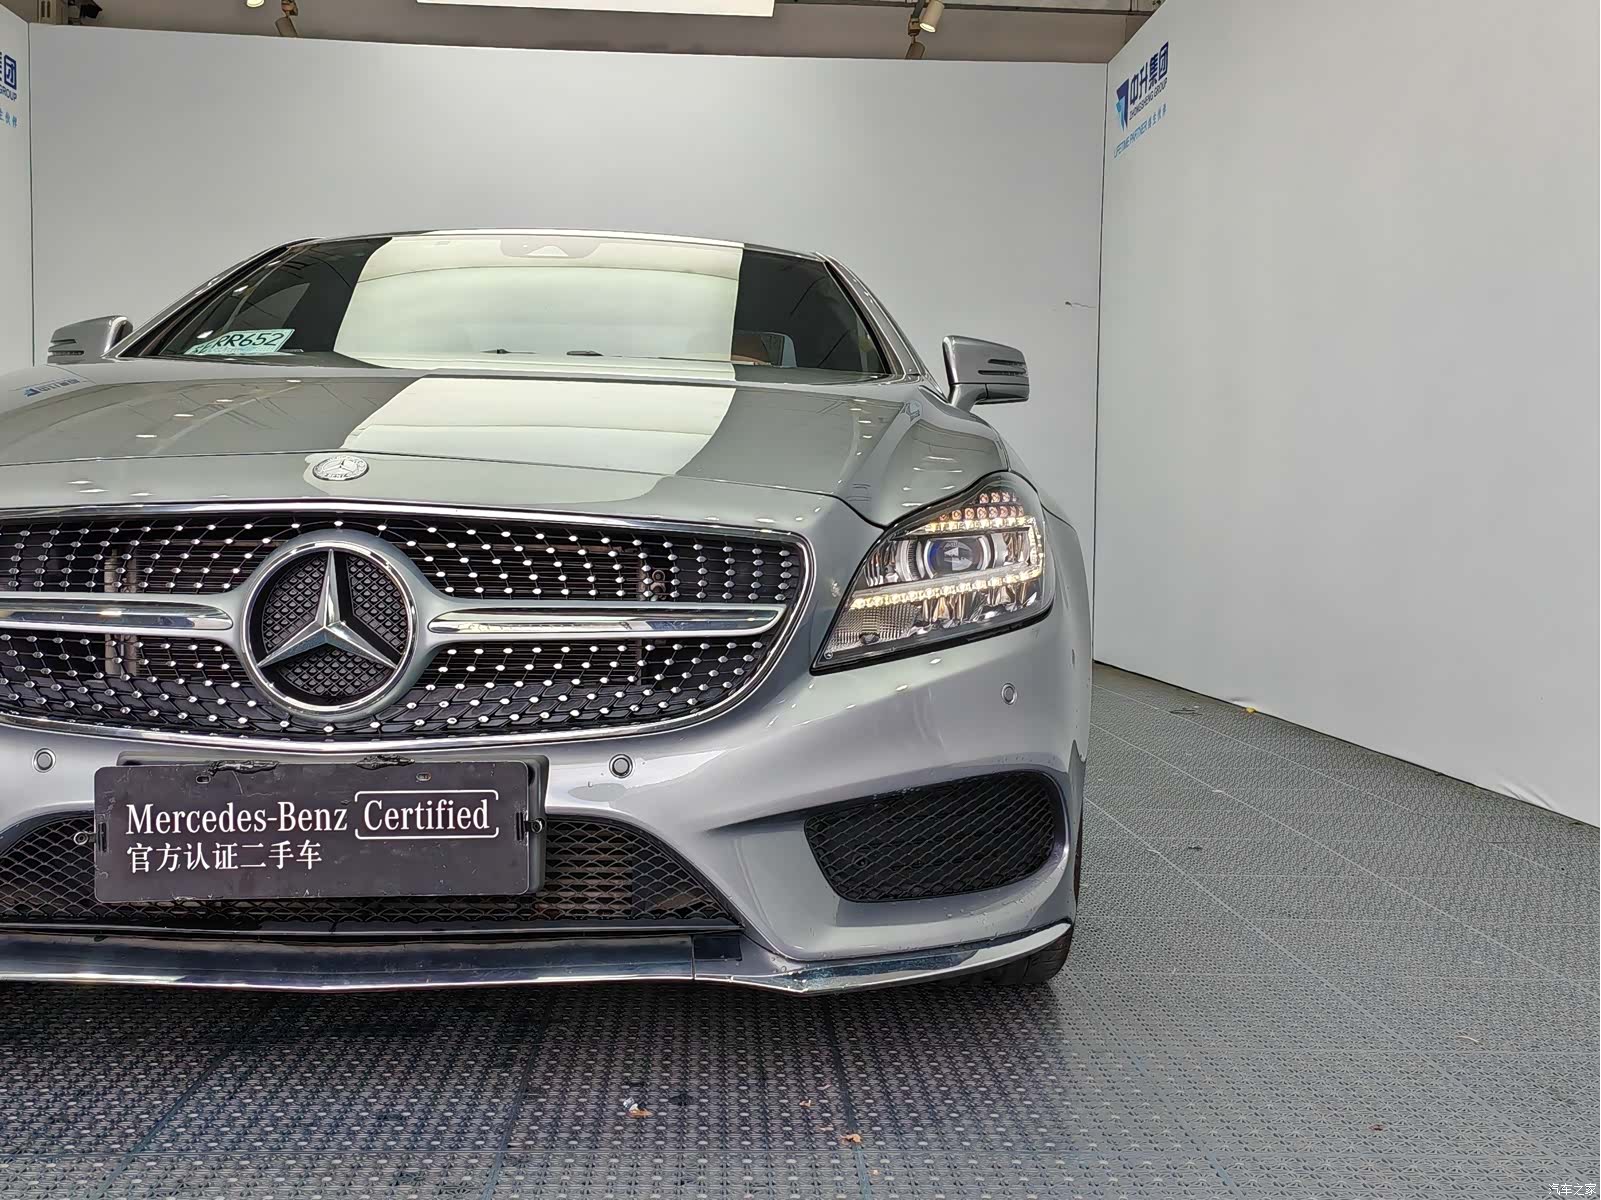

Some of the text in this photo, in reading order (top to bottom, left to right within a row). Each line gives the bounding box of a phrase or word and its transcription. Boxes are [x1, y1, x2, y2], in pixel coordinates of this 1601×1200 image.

[0, 51, 17, 90] 团
[1129, 41, 1169, 106] 中升集团
[1153, 77, 1168, 98] GROUP
[125, 798, 490, 835] Mercedes-Benz Certified
[126, 839, 323, 874] 官方认证二手车
